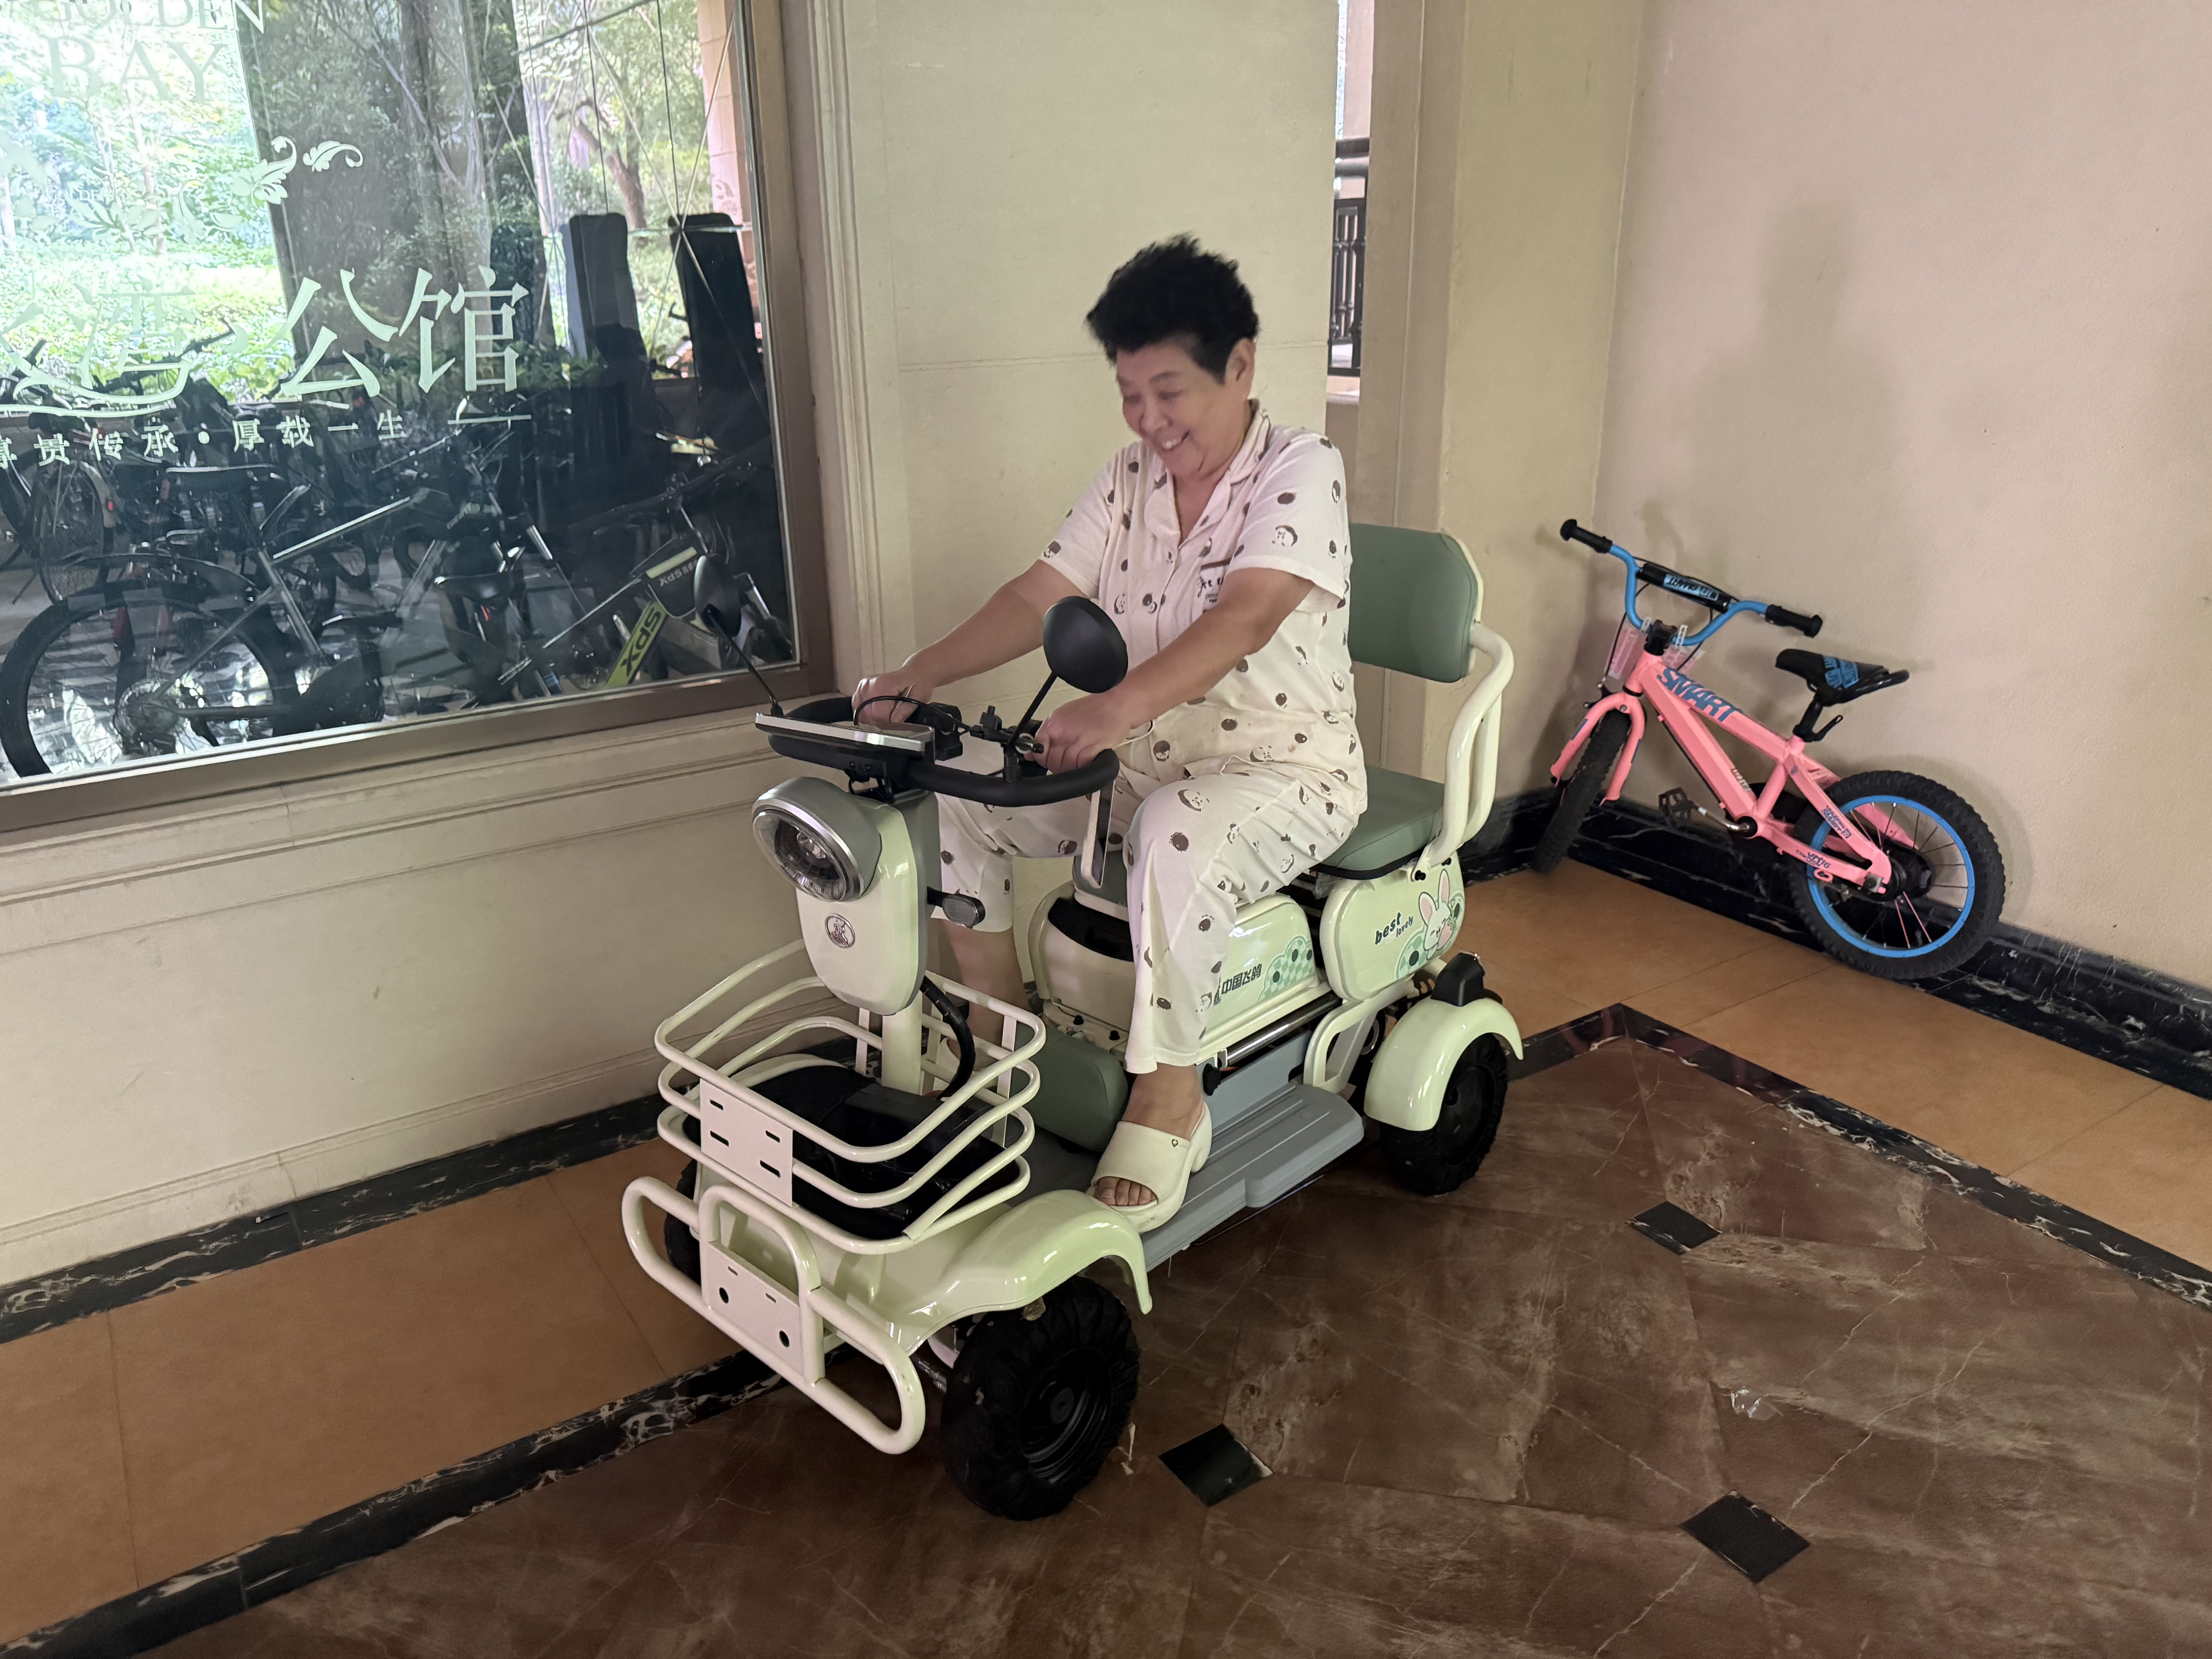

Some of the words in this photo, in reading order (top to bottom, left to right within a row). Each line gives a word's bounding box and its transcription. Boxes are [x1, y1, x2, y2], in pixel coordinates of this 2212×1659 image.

[41, 36, 227, 102] BAY
[1657, 666, 1744, 722] SMART
[1375, 912, 1401, 945] best
[1396, 915, 1413, 938] lovely
[1221, 963, 1262, 994] 中国飞鸽
